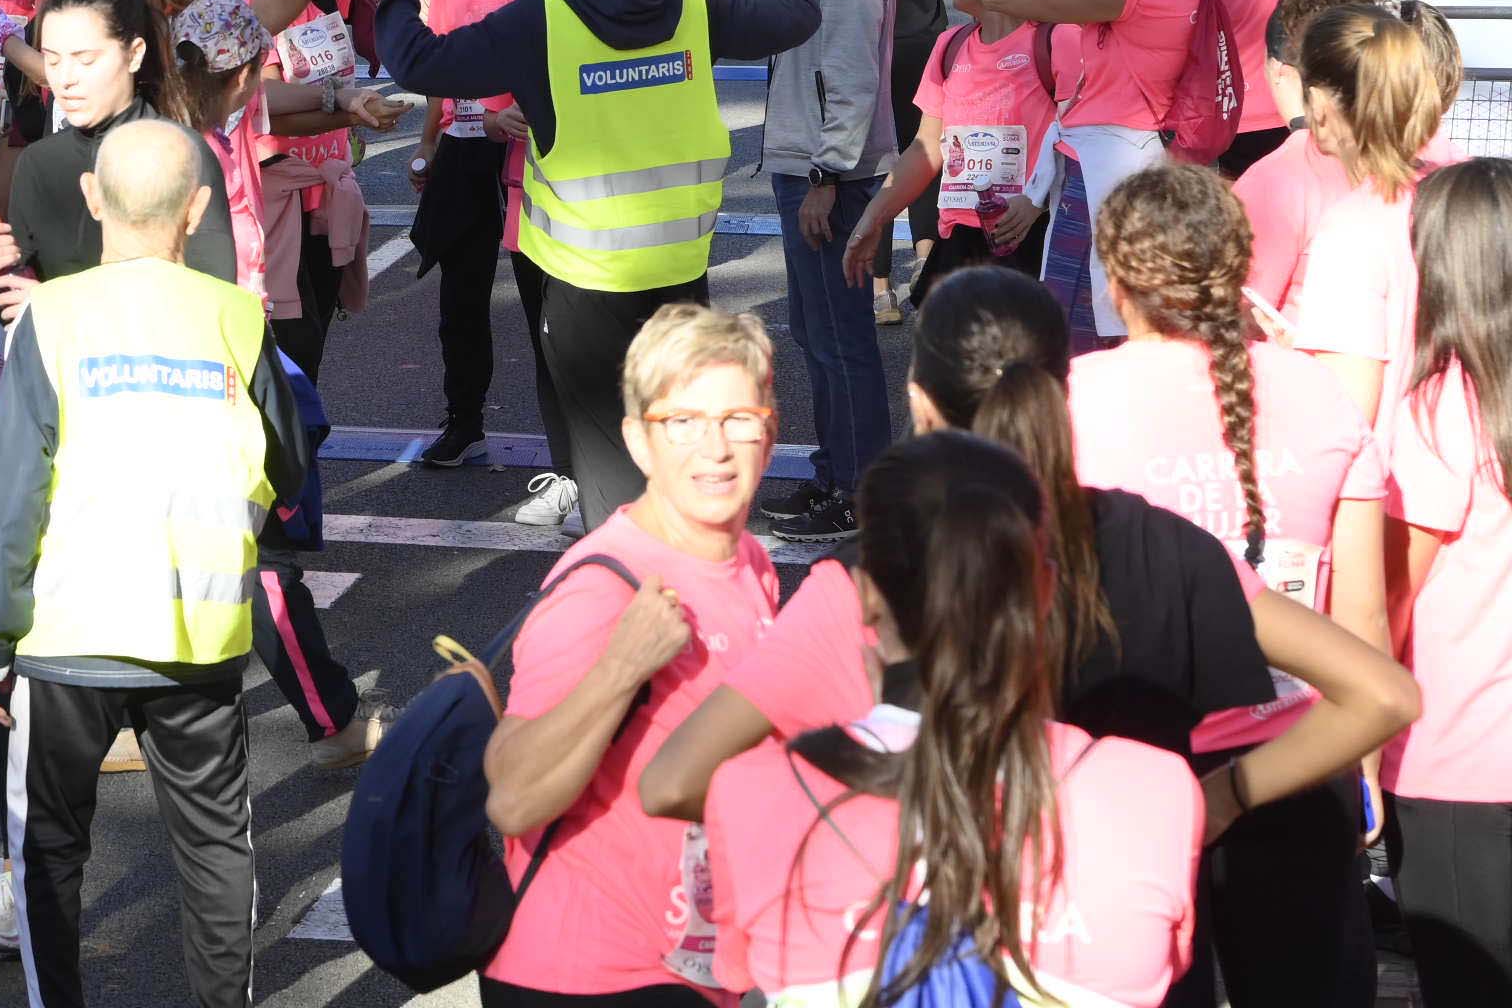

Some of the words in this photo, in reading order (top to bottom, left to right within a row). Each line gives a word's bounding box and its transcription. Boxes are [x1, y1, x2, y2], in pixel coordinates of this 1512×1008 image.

[310, 49, 334, 67] 016
[582, 60, 684, 87] VOLUNTARIS
[967, 159, 993, 171] 016
[84, 362, 224, 393] VOLUNTARIS
